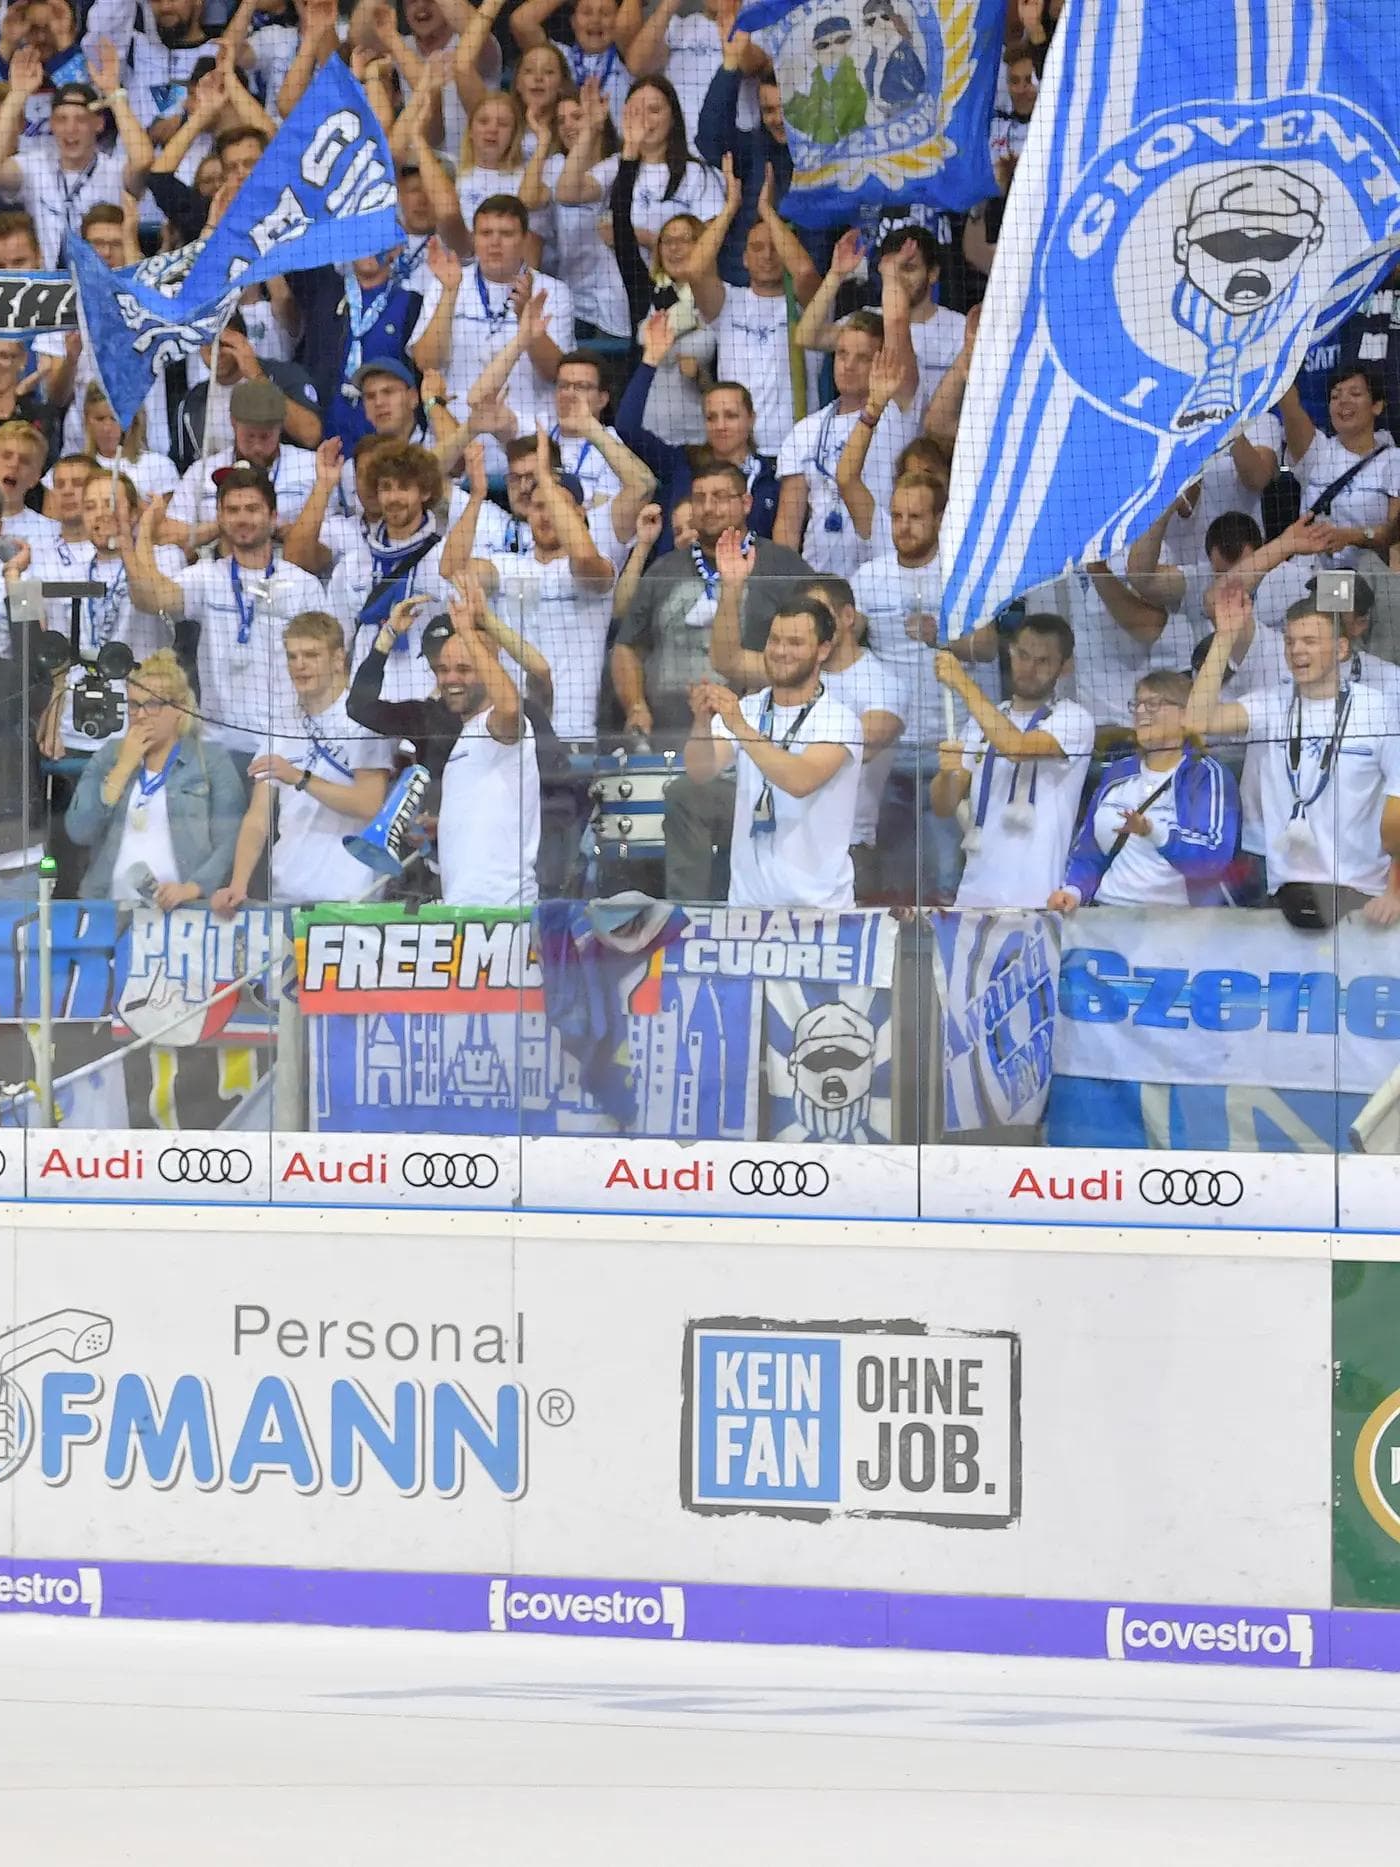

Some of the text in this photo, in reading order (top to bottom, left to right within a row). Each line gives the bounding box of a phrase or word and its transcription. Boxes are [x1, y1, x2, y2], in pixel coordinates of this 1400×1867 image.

[303, 924, 455, 991] FREE
[683, 939, 854, 981] CUORE
[1058, 947, 1400, 1040] Szene
[40, 1148, 144, 1180] Audi
[282, 1151, 388, 1185] Audi
[604, 1158, 715, 1192] Audi
[1008, 1167, 1123, 1202] Audi
[232, 1304, 525, 1365] Personal
[715, 1350, 821, 1412] KEIN
[857, 1355, 984, 1416] OHNE
[715, 1414, 821, 1489] FAN
[857, 1421, 996, 1495] JOB.
[506, 1588, 662, 1625] covestro
[1124, 1618, 1289, 1654] covestro
